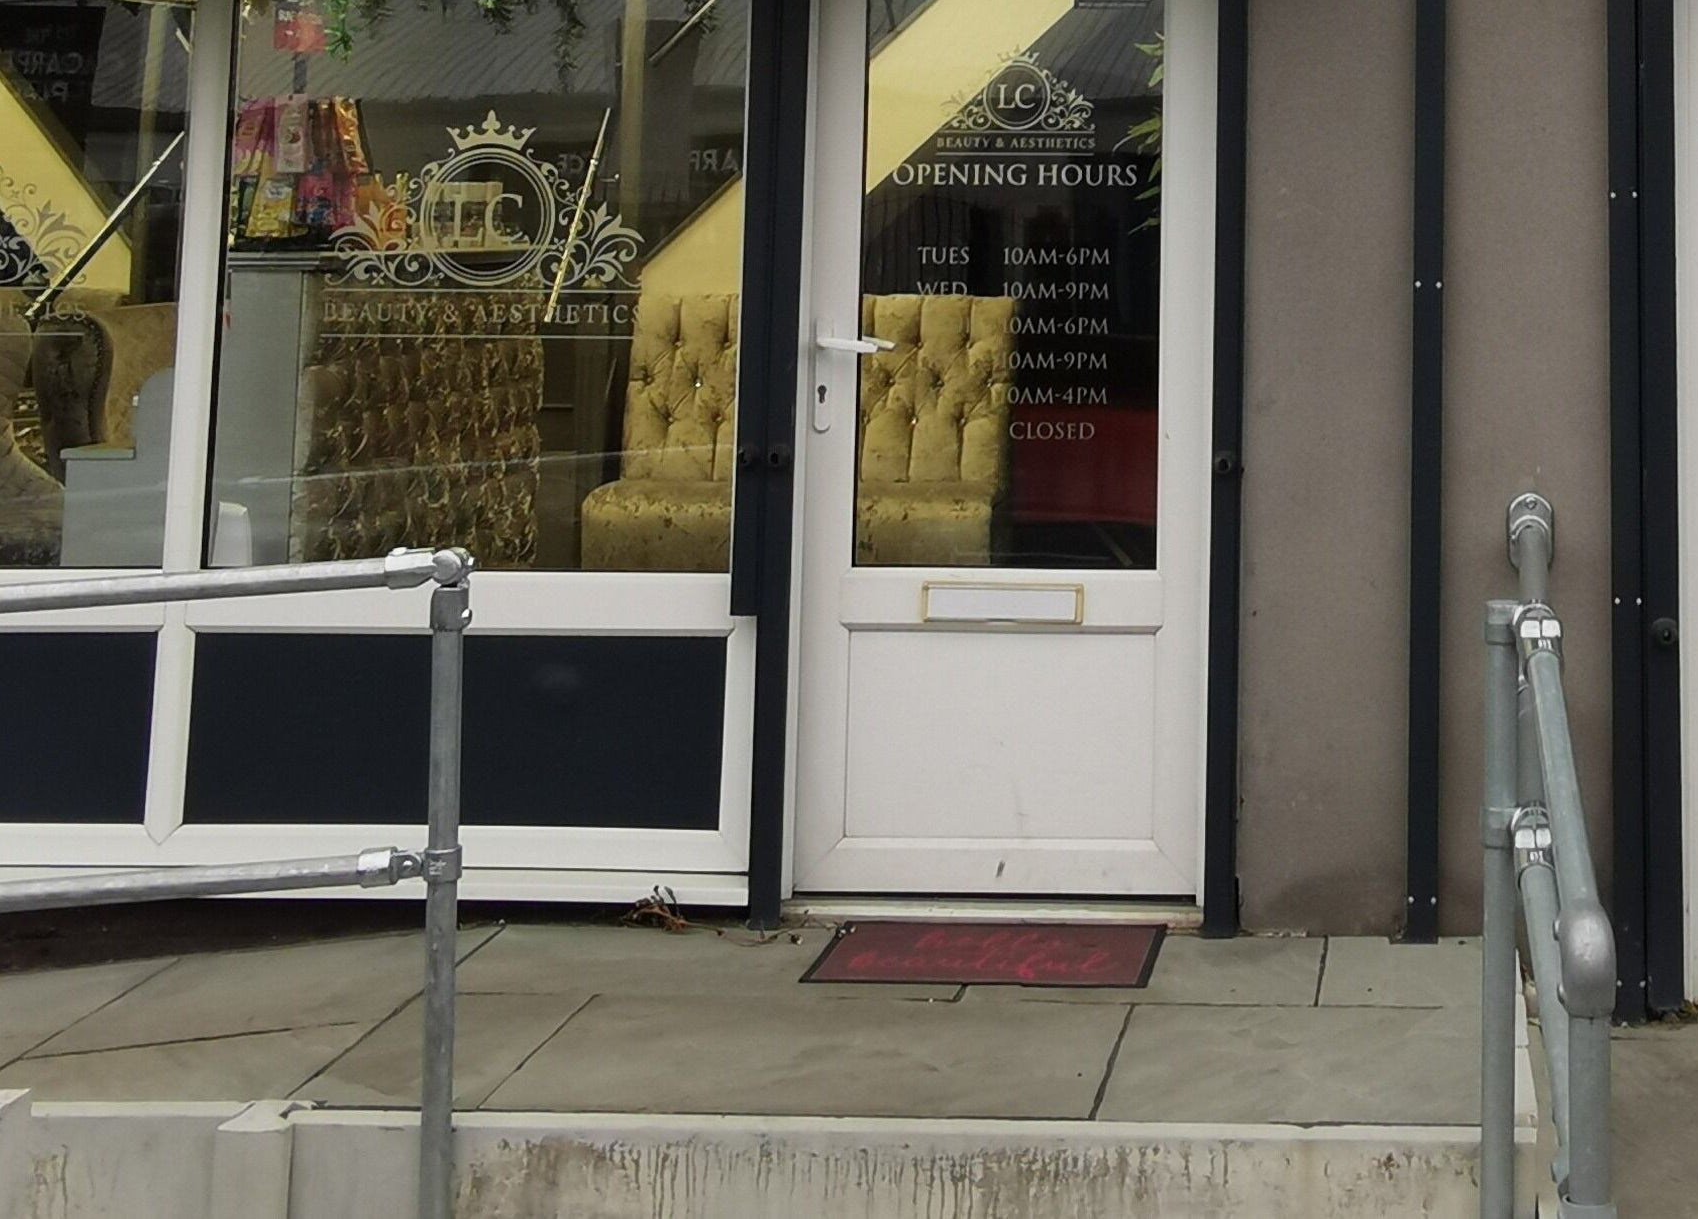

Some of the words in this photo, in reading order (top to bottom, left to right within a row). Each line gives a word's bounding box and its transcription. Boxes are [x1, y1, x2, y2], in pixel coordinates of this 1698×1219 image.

[996, 82, 1037, 110] LC
[936, 136, 991, 150] BEAUTY
[995, 136, 1006, 149] &
[1010, 136, 1097, 151] AESTHETICS
[892, 162, 1028, 187] OPENING
[1037, 163, 1138, 188] HOURS
[917, 246, 970, 266] TUES
[1003, 246, 1111, 266] 10AM-6PM
[917, 280, 968, 296] WED
[1002, 282, 1110, 301] 10AM-9PM
[323, 301, 429, 325] BEAUTY
[443, 302, 458, 323] &
[1007, 386, 1108, 405] 0AM-4PM
[1009, 420, 1096, 440] CLOSED
